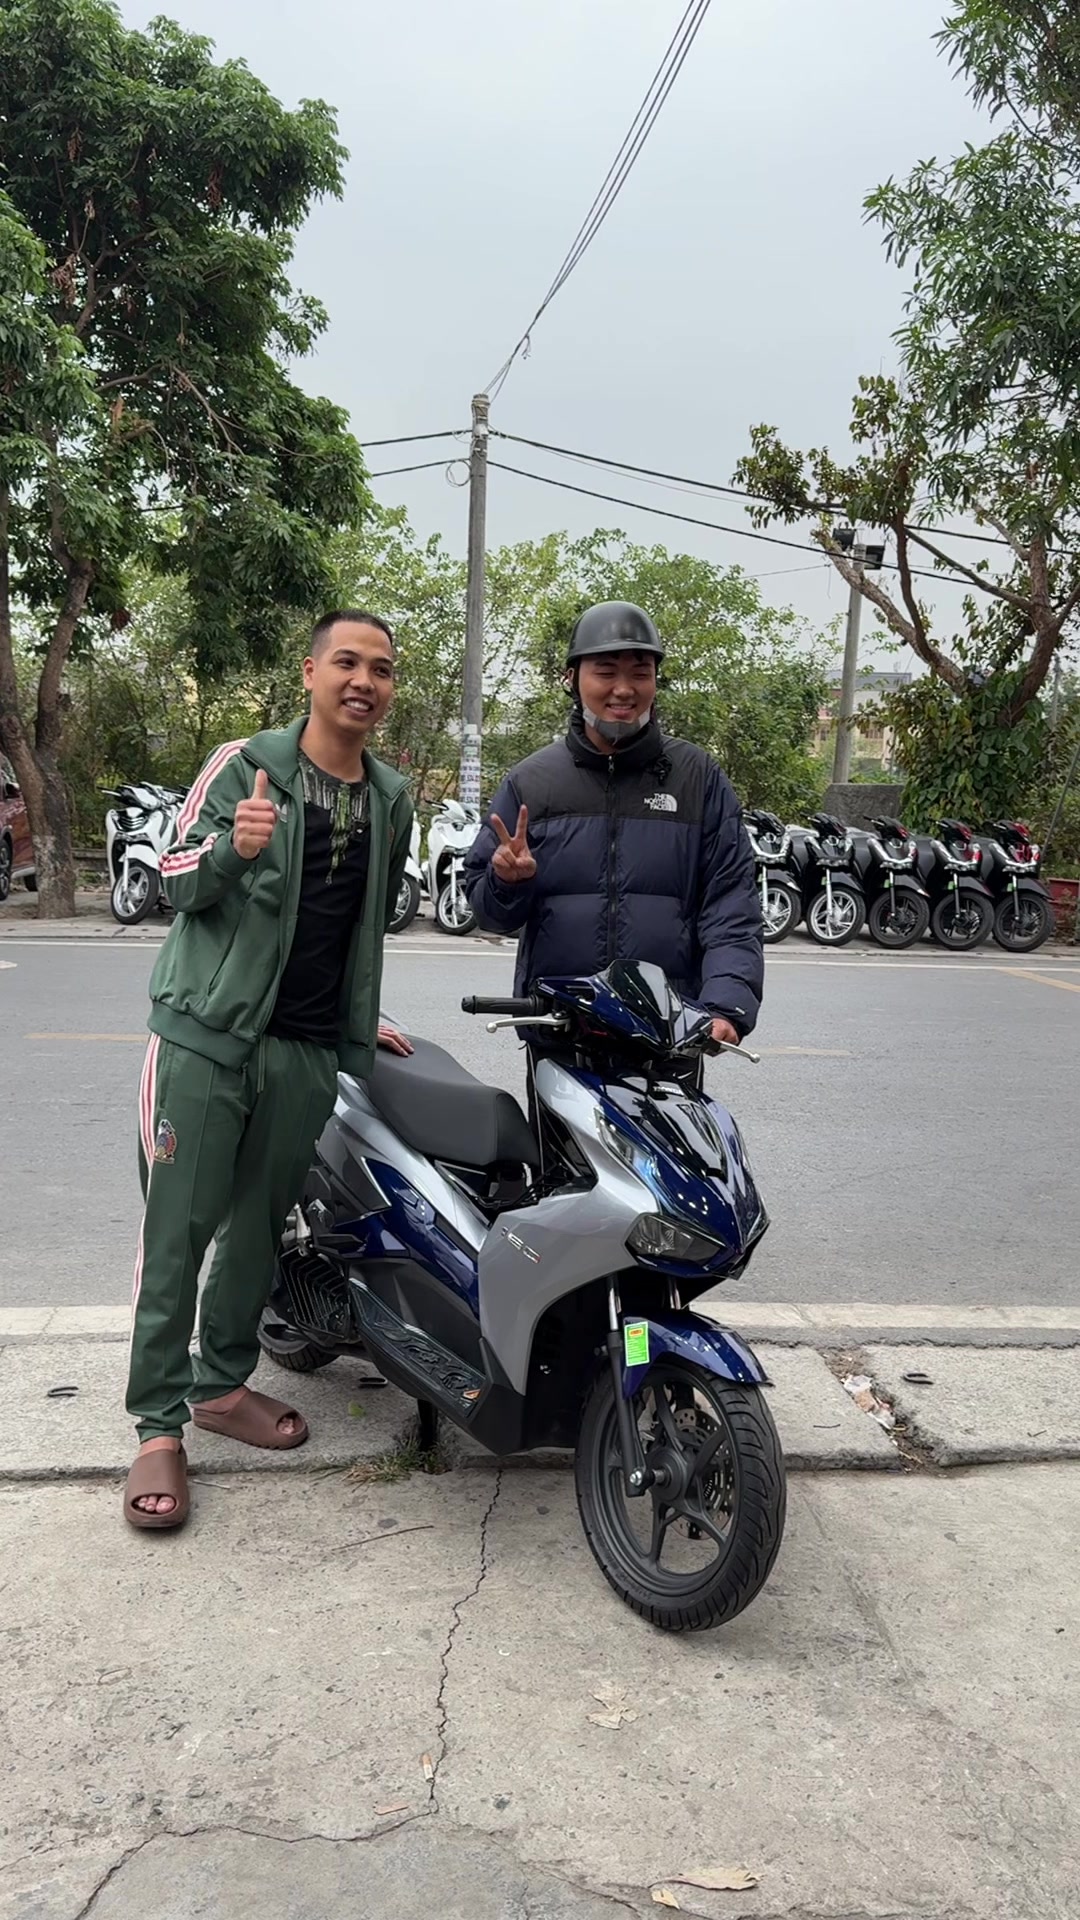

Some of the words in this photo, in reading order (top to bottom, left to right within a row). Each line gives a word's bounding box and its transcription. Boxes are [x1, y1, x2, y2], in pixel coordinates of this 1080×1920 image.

[643, 797, 666, 805] NORTH
[654, 793, 666, 801] THE
[650, 803, 666, 811] FACE
